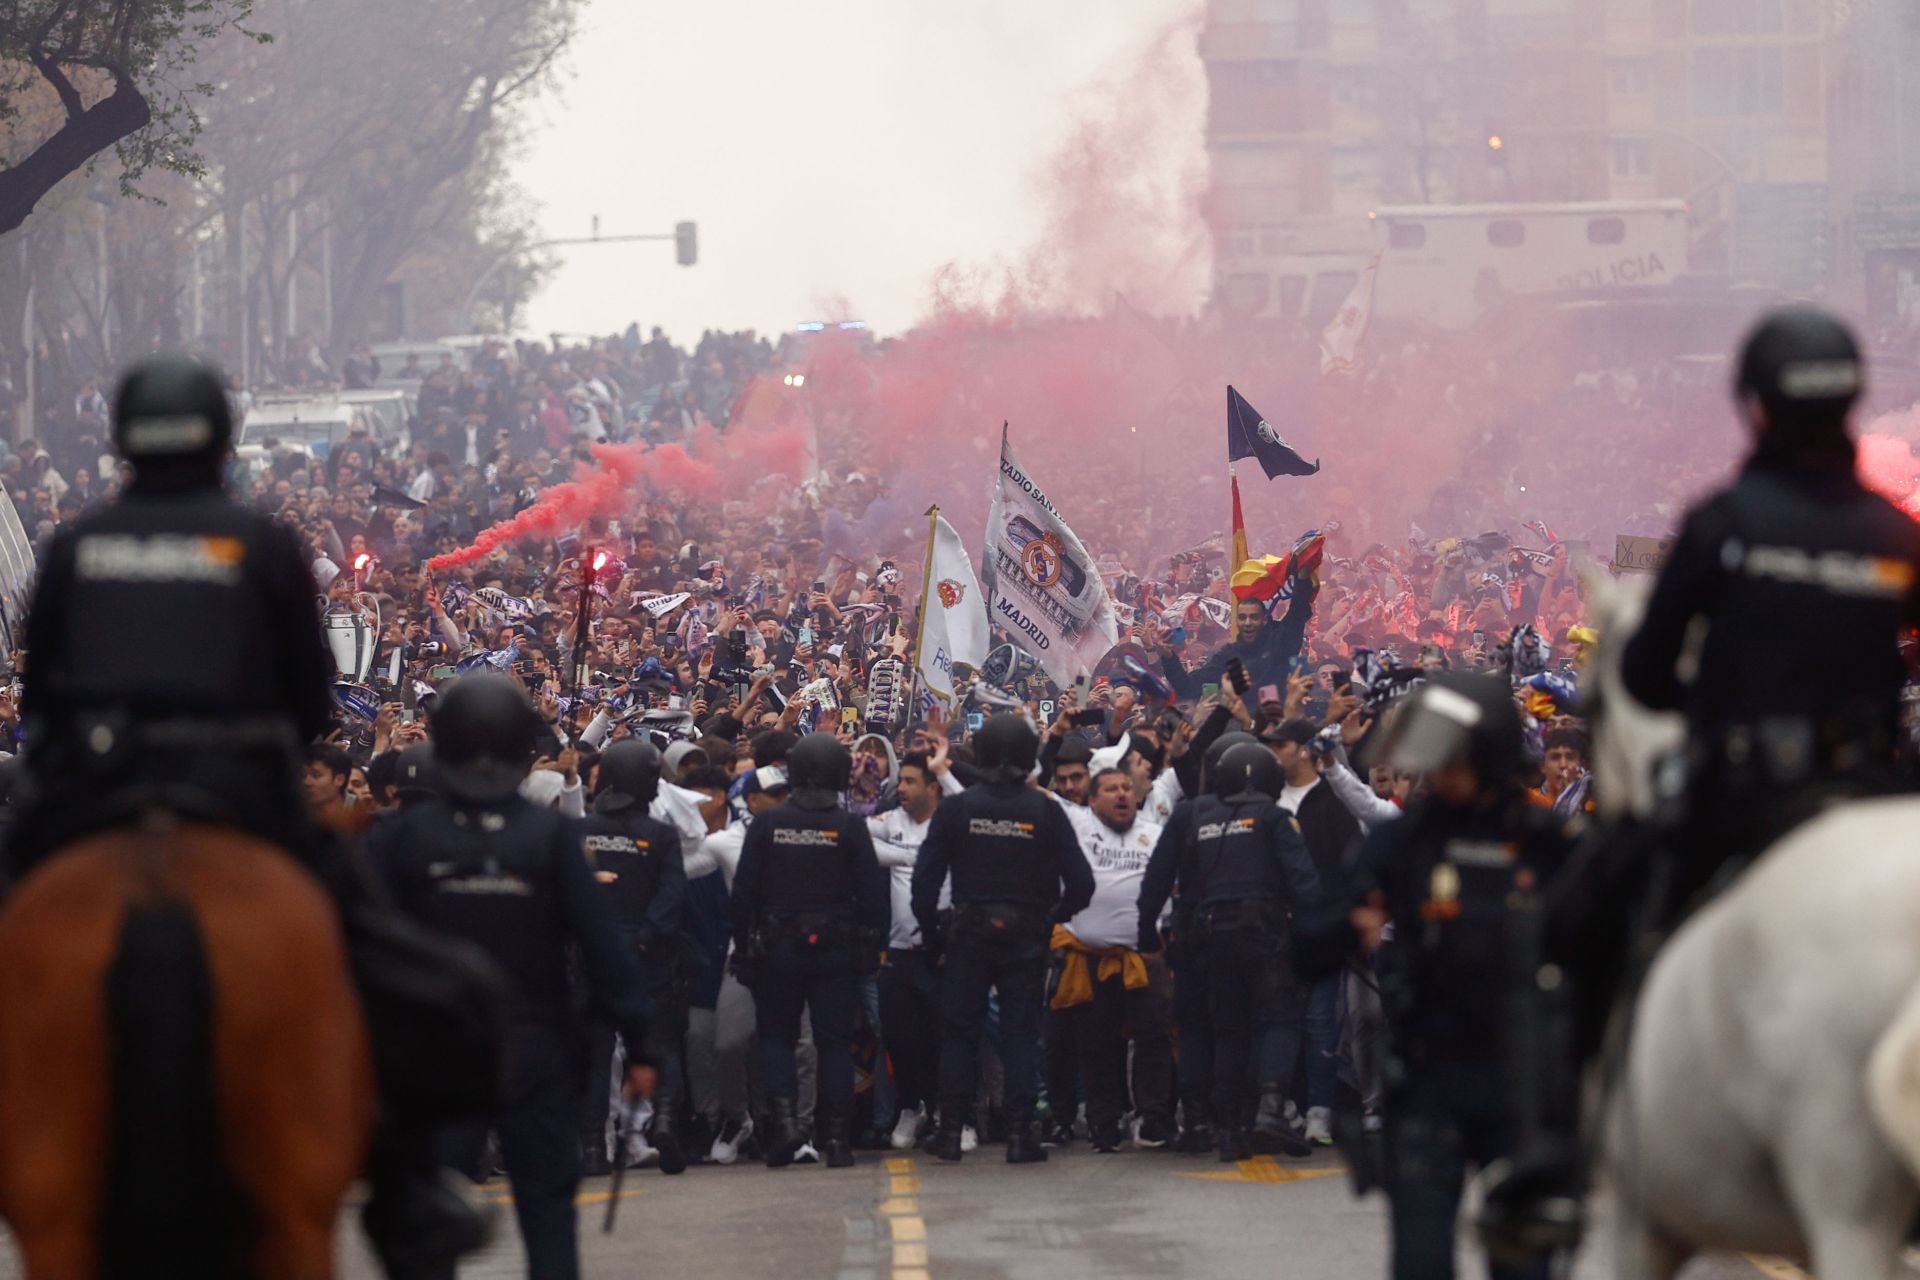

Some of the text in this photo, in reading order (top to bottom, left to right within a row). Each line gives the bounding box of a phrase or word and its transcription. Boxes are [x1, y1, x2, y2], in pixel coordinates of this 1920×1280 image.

[1557, 251, 1665, 289] POLICIA
[1001, 458, 1032, 493] TADIO
[998, 597, 1050, 650] MADRID
[774, 829, 824, 839] POLICIA
[1093, 843, 1149, 860] Emirates
